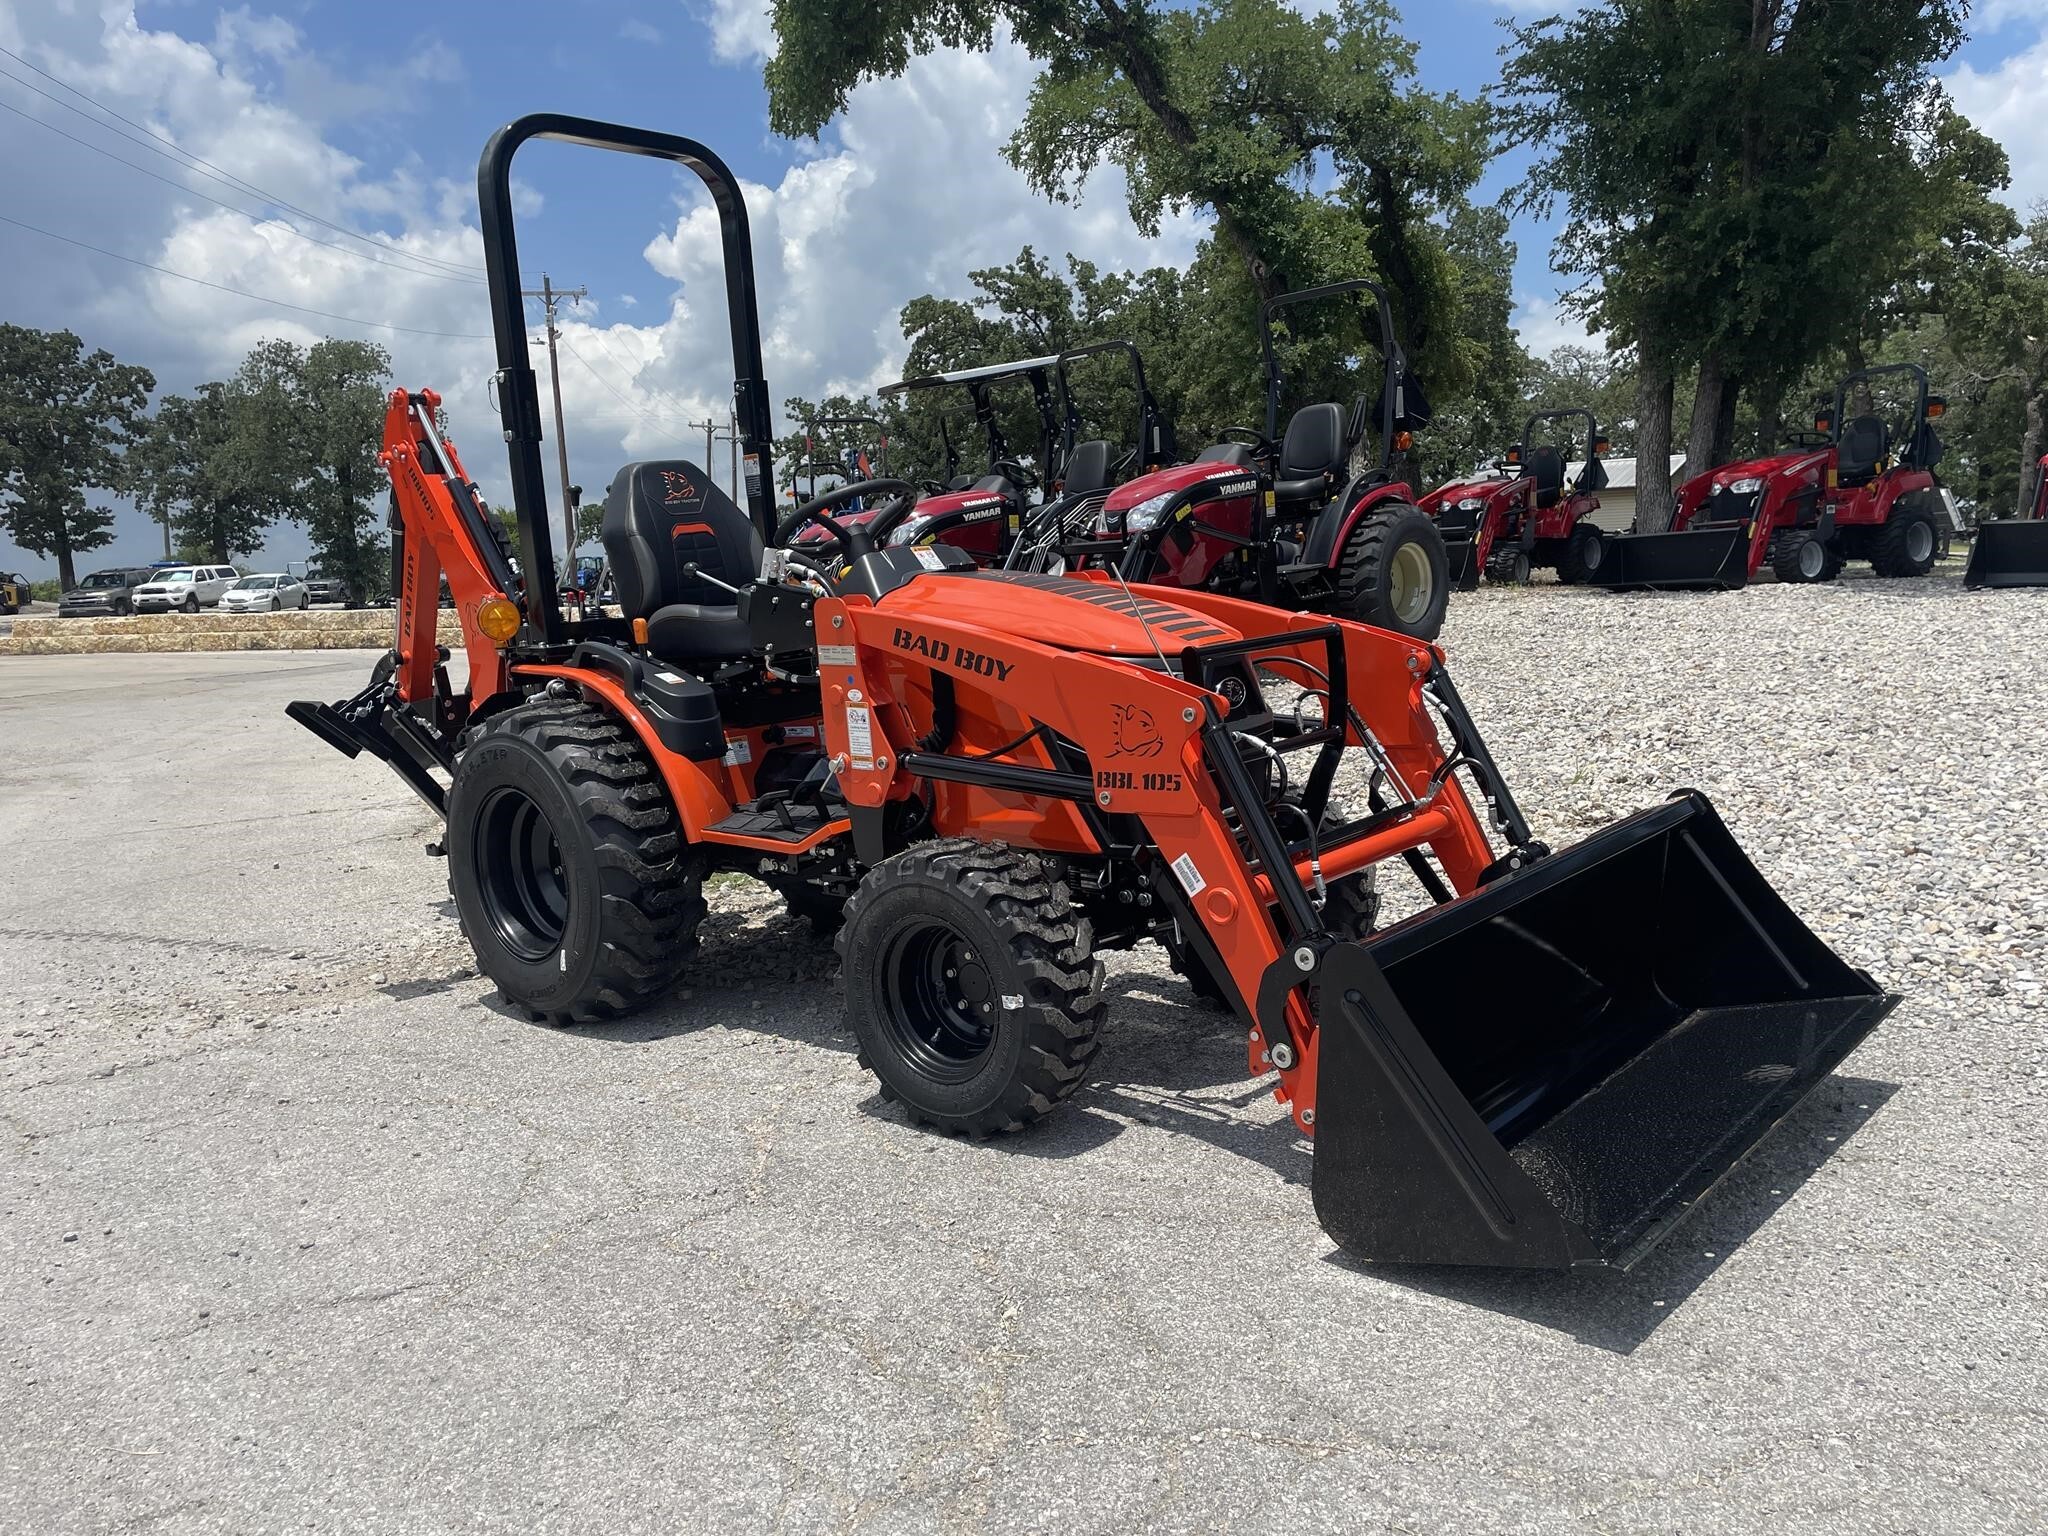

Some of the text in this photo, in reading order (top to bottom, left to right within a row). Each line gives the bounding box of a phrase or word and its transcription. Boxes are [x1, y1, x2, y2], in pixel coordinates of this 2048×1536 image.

[1219, 480, 1257, 495] YANMAR
[961, 497, 992, 508] YANMAR
[963, 507, 1000, 522] YANMAR
[404, 551, 414, 638] BAD BOY
[892, 627, 950, 662] BAD
[954, 647, 1016, 682] BOY
[1097, 771, 1182, 791] BBL 105
